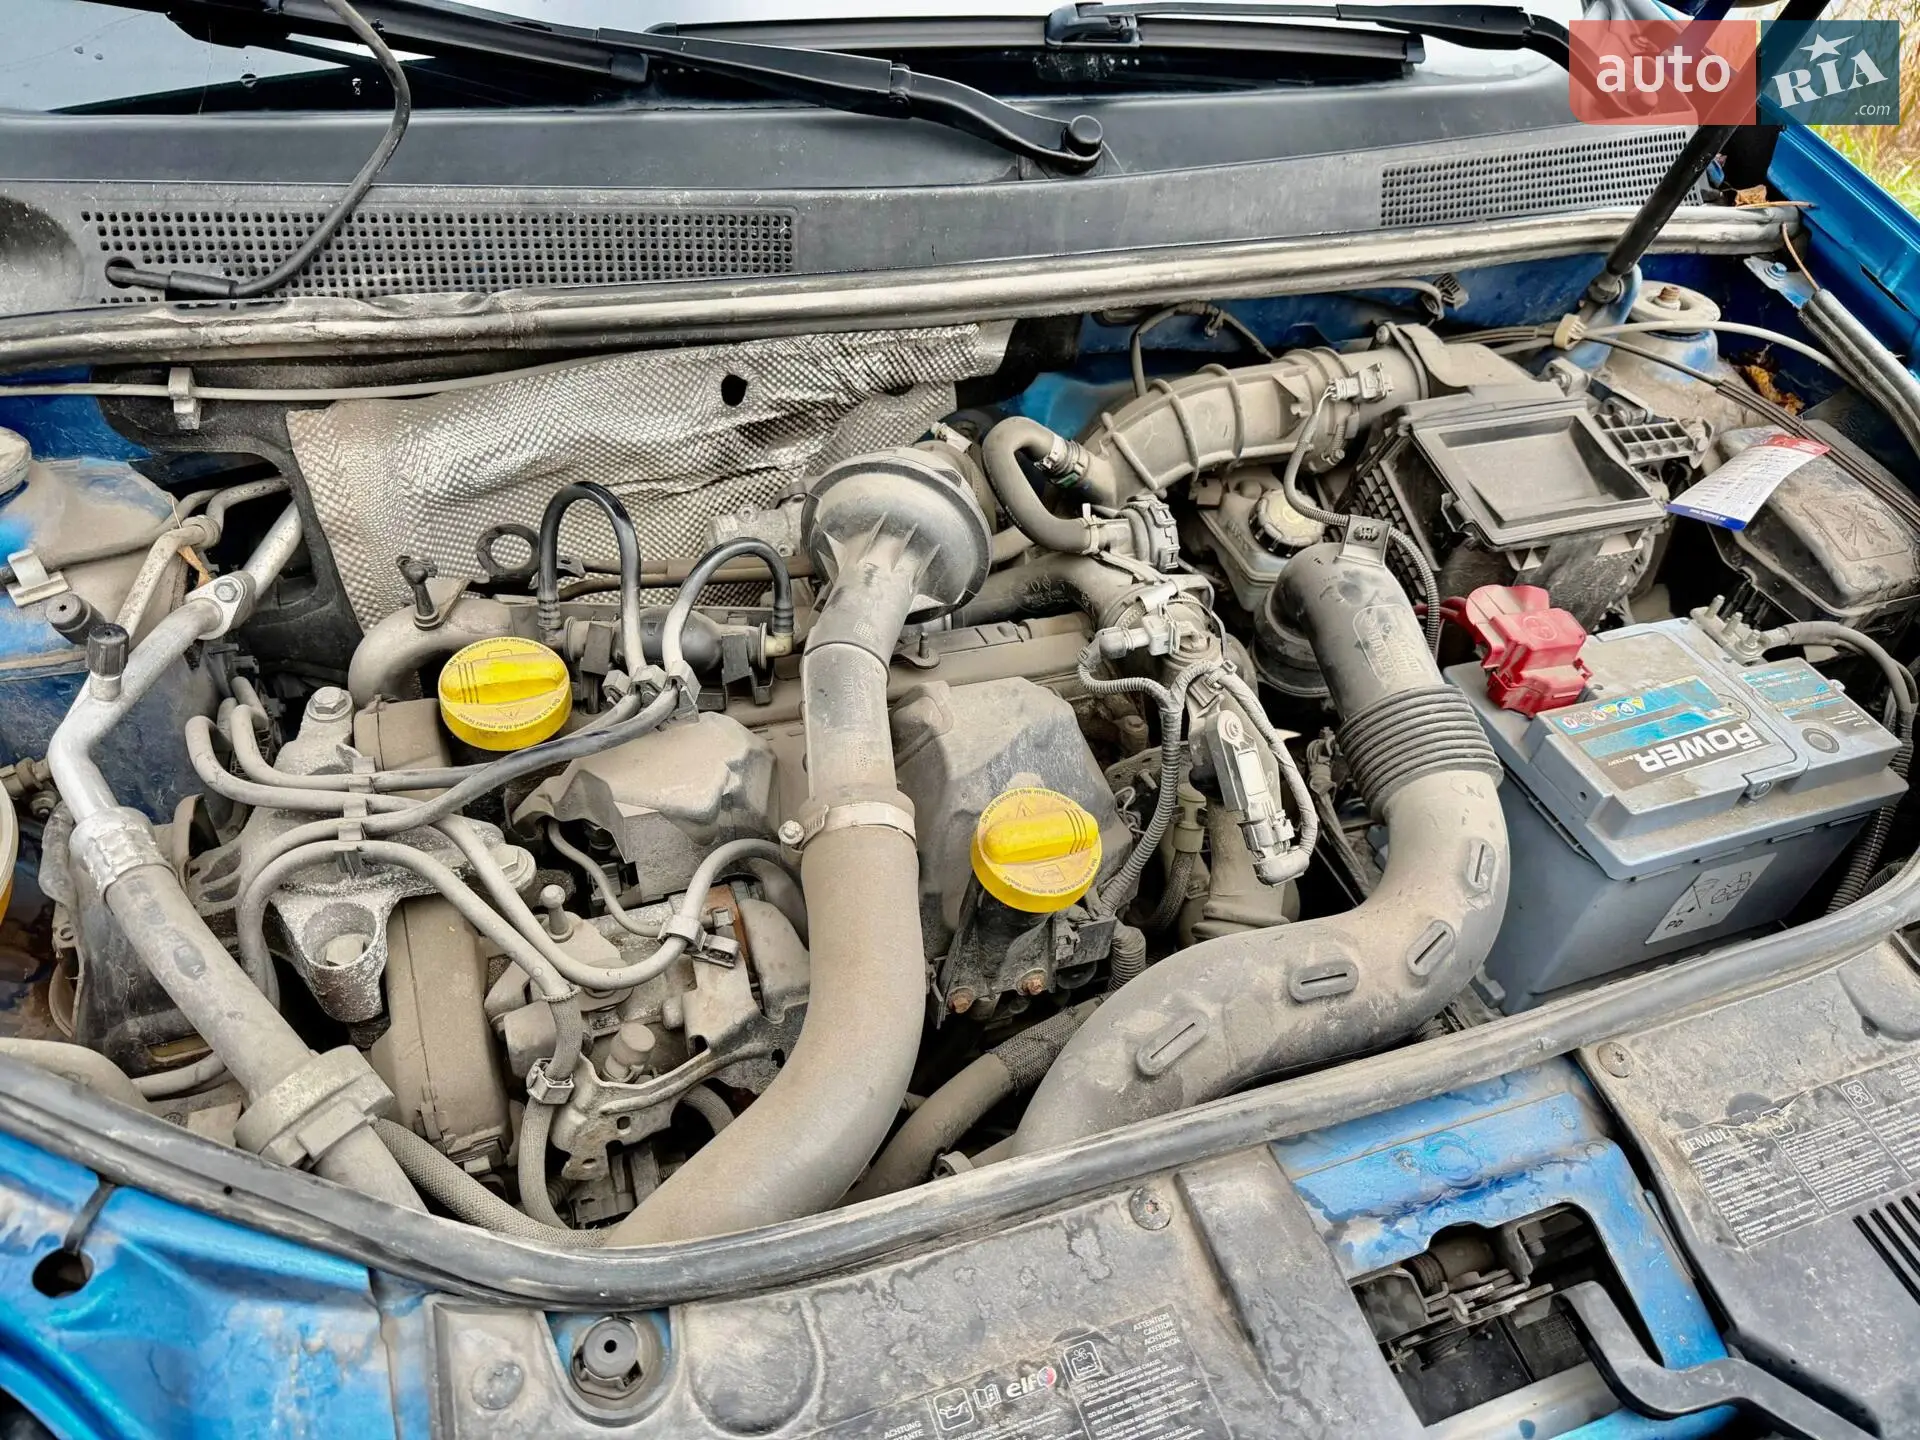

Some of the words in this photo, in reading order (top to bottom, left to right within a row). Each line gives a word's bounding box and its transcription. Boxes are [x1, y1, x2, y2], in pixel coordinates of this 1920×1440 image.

[1638, 722, 1759, 773] POWER
[1679, 1128, 1735, 1157] RENAULT
[1133, 1312, 1169, 1331] ATTENTION
[1143, 1320, 1173, 1336] CAUTION
[1144, 1329, 1177, 1345] ACHTUNG
[1006, 1373, 1037, 1398] elf
[884, 1421, 922, 1439] ACHTUNG
